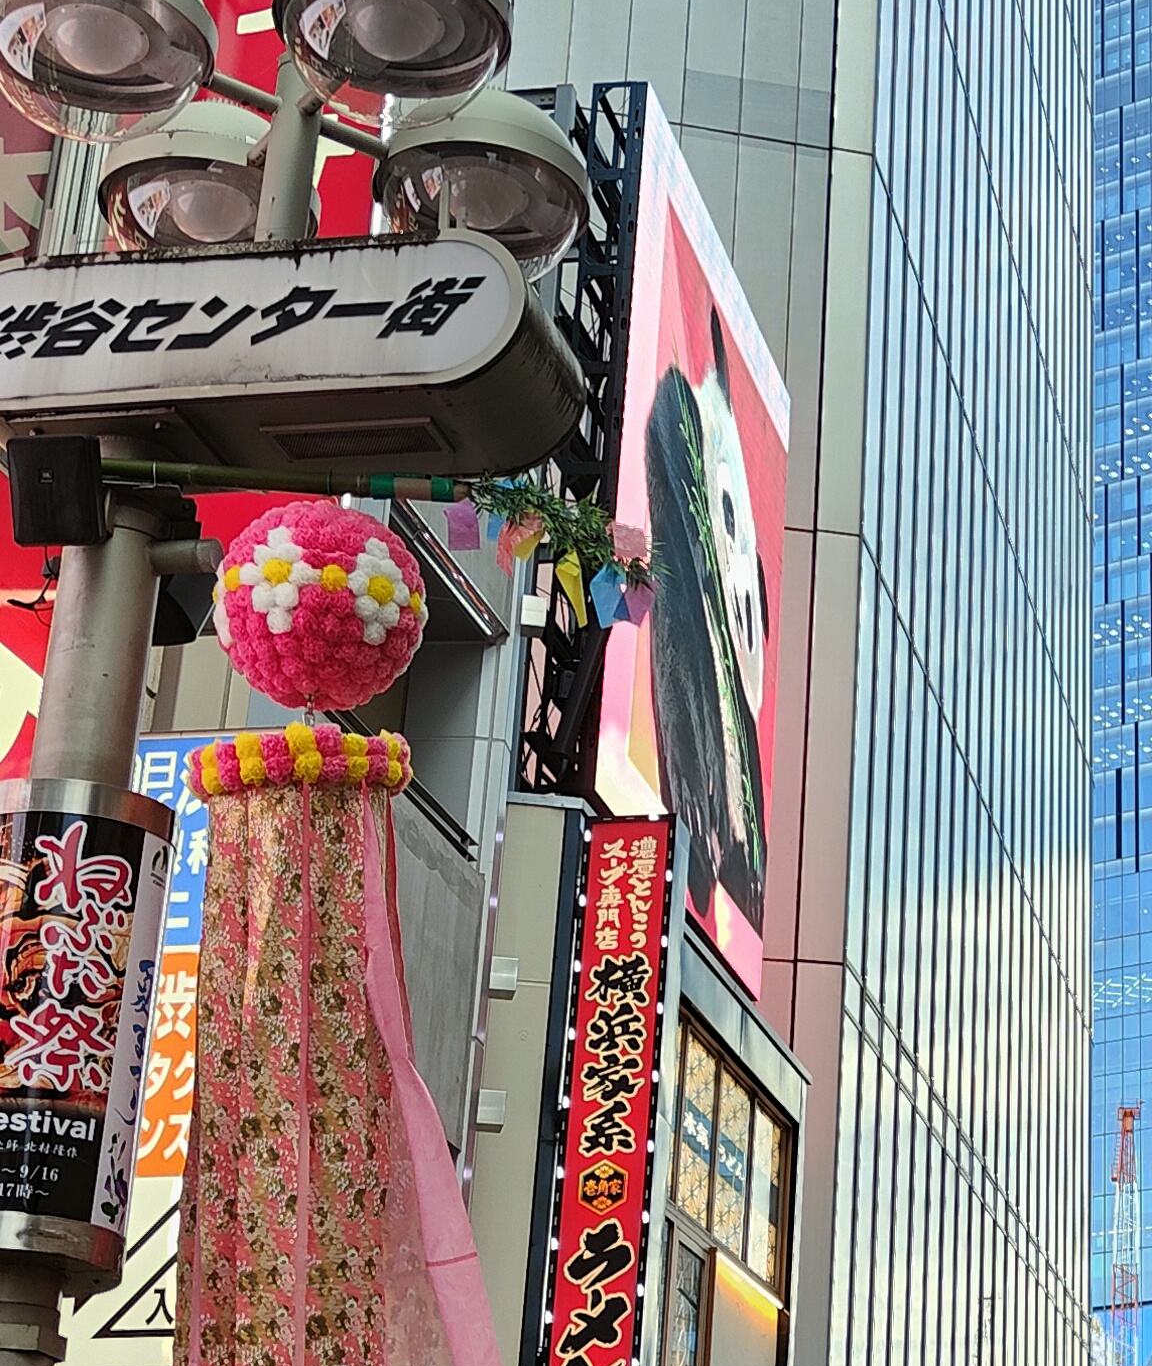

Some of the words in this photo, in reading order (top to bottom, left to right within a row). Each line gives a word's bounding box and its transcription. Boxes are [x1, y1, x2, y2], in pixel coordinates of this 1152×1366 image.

[0, 276, 487, 360] 渋谷センター街
[593, 837, 628, 950] スープ専門店
[625, 835, 658, 949] 濃厚とんこつ
[5, 820, 132, 1091] ねぶた祭
[577, 954, 653, 1157] 横浜家系
